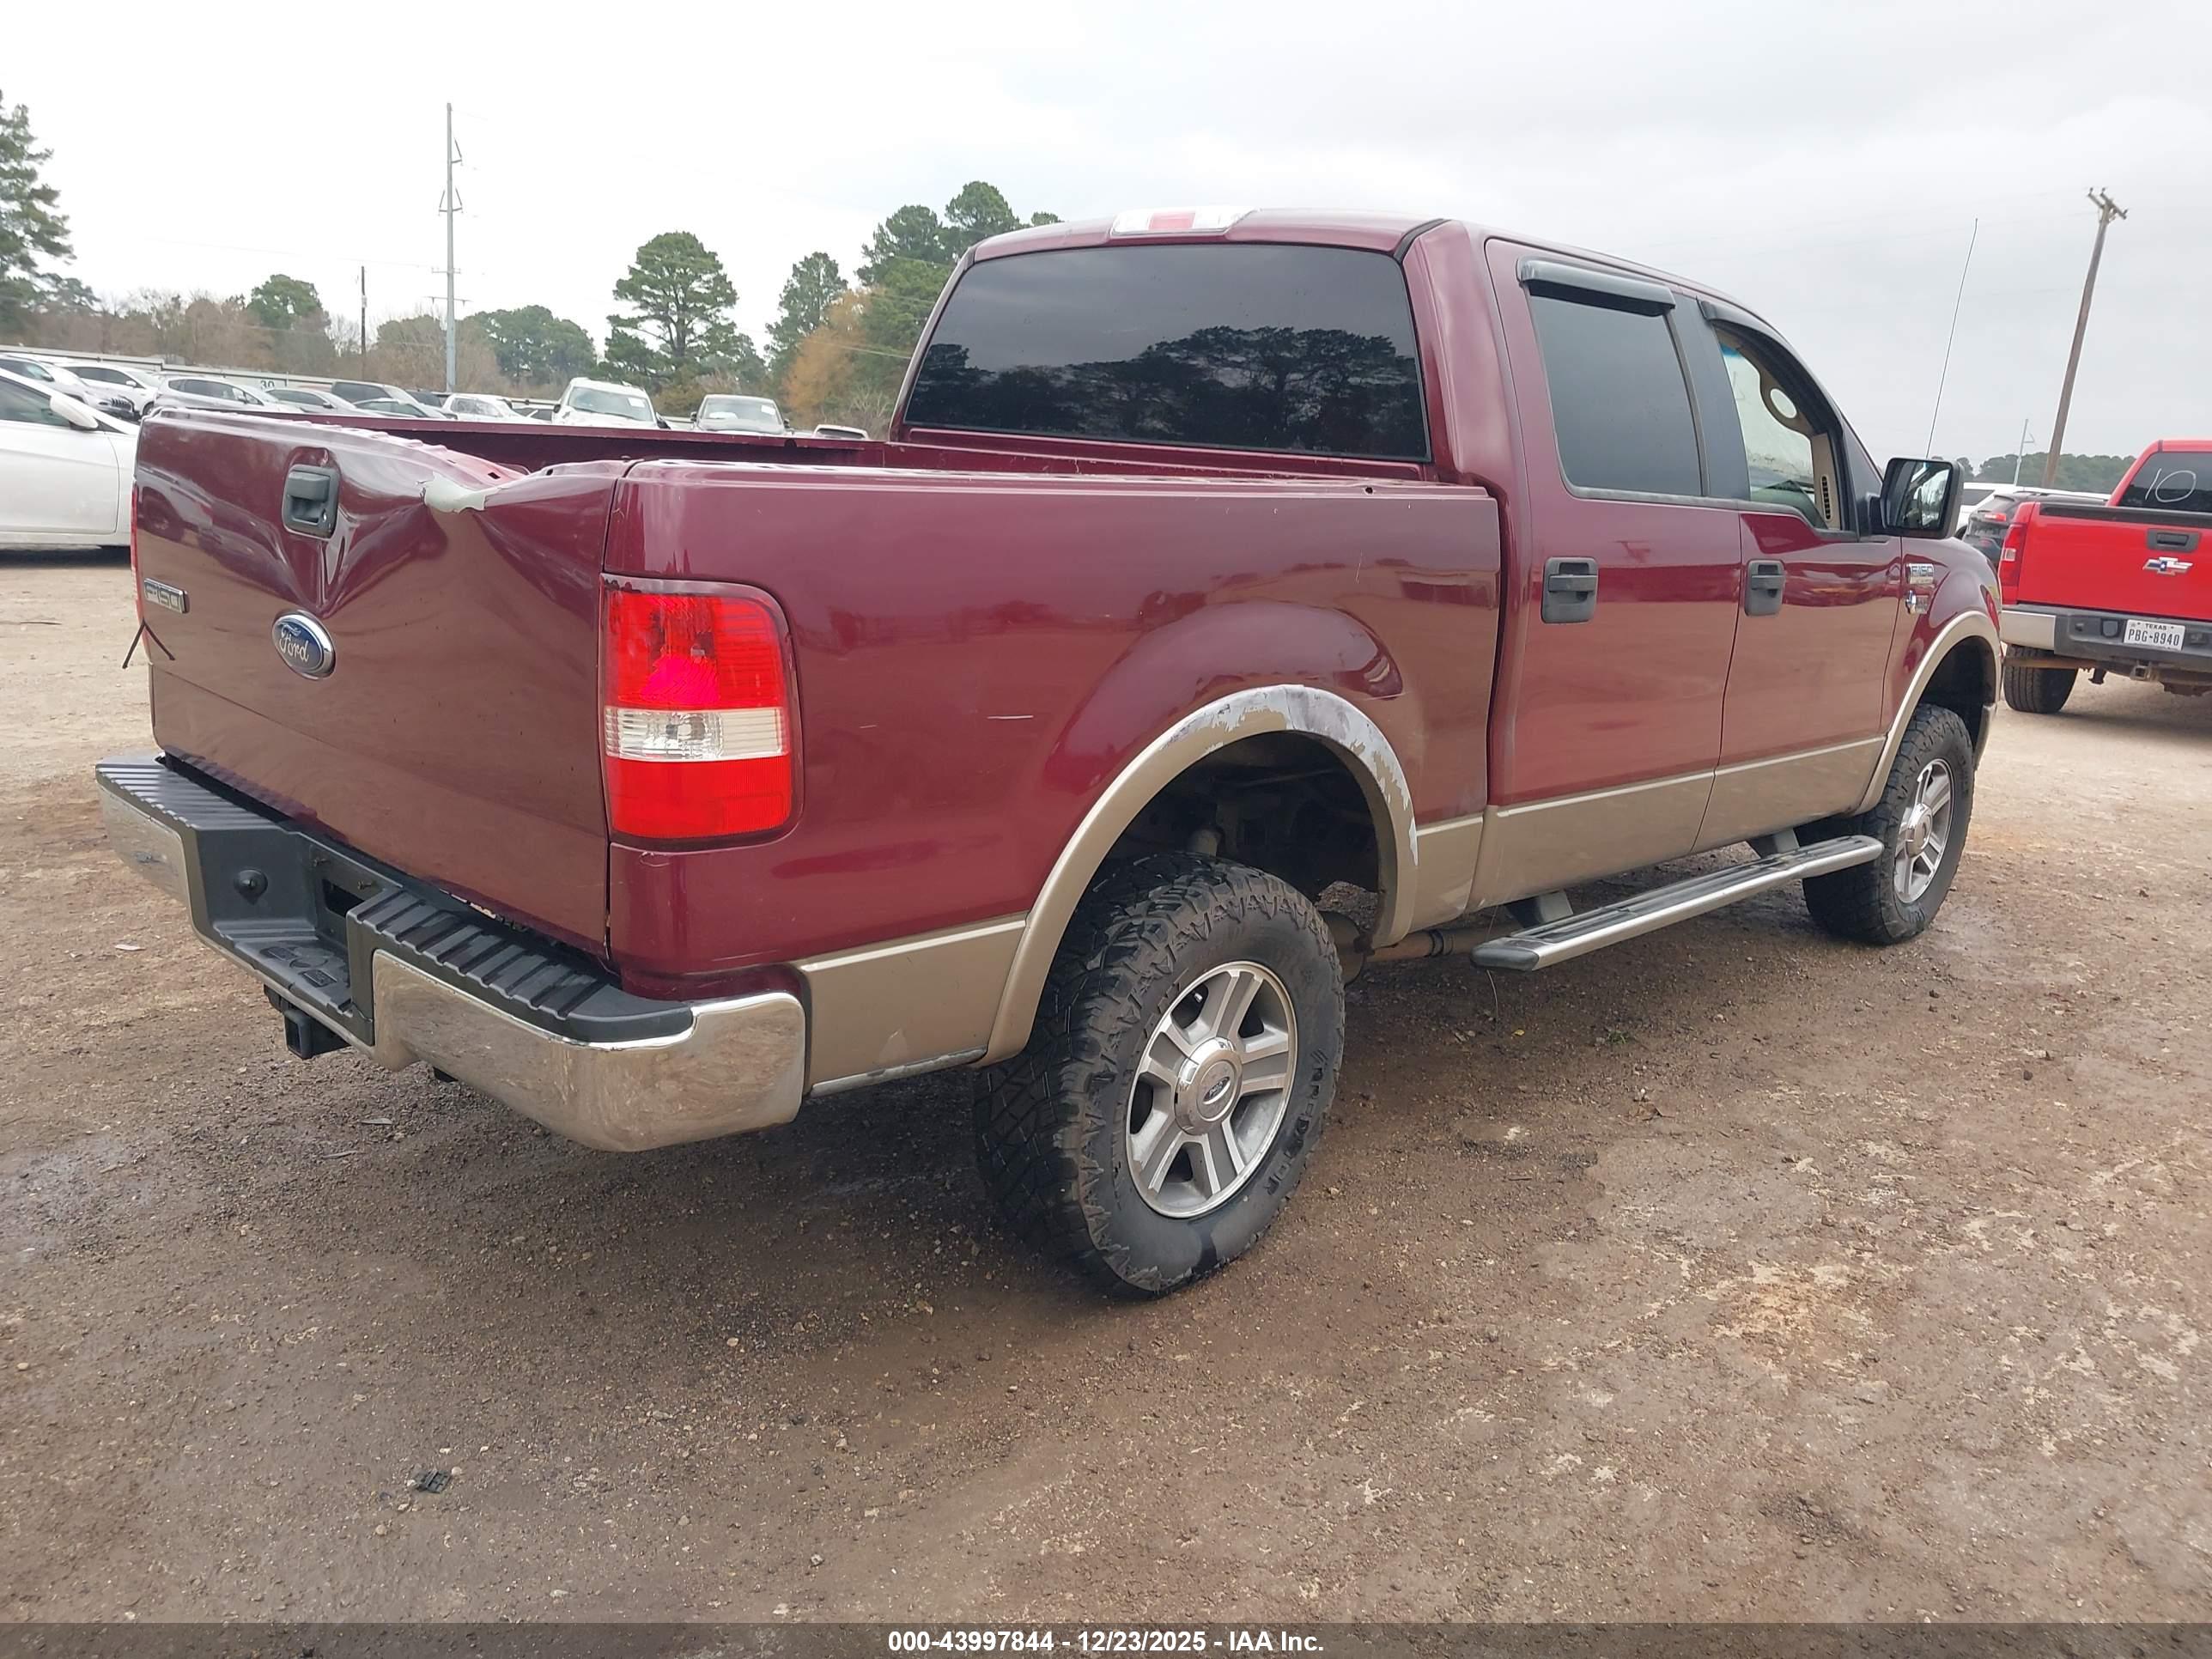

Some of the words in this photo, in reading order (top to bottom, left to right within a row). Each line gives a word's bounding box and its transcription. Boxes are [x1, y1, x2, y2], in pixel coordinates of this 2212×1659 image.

[2145, 468, 2197, 503] 10
[277, 623, 310, 662] Ford
[2145, 623, 2167, 631] TEXAS
